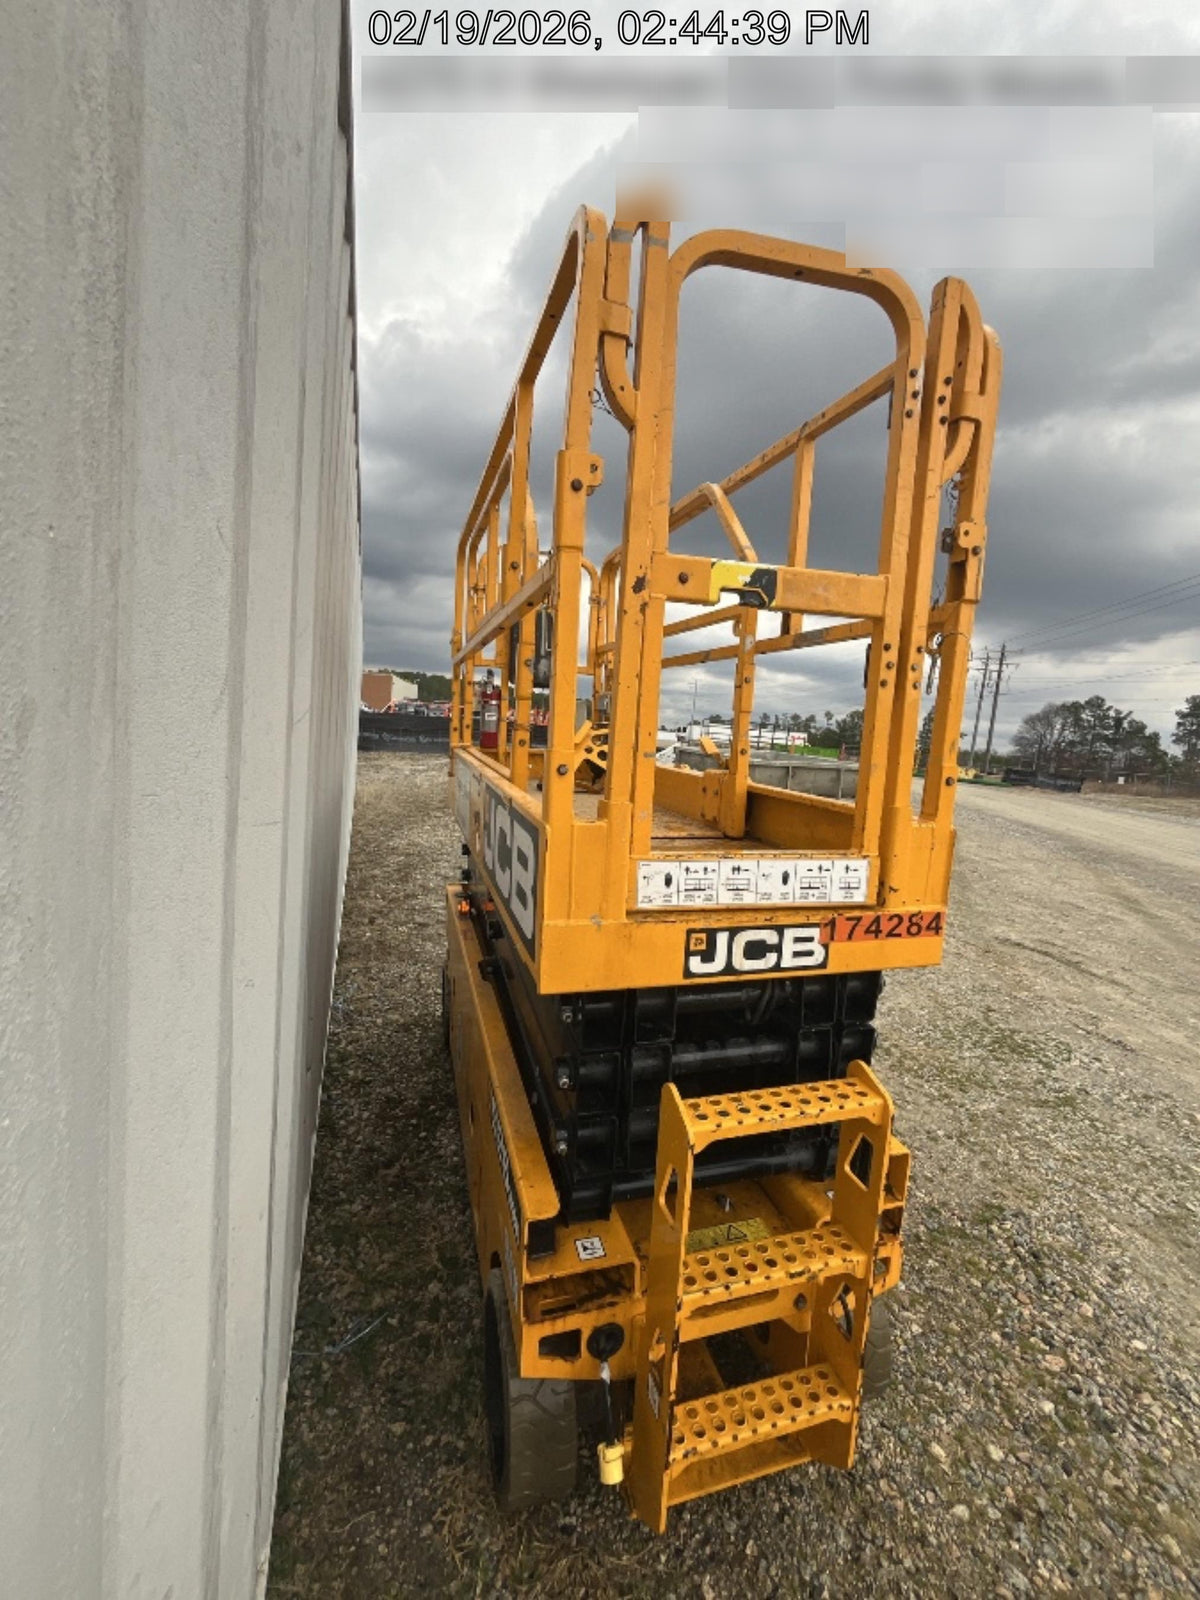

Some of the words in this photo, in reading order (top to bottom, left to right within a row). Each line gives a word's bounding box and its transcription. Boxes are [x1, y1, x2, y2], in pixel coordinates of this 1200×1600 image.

[484, 798, 535, 940] JCB
[822, 911, 943, 941] 174284
[688, 927, 826, 974] JCB
